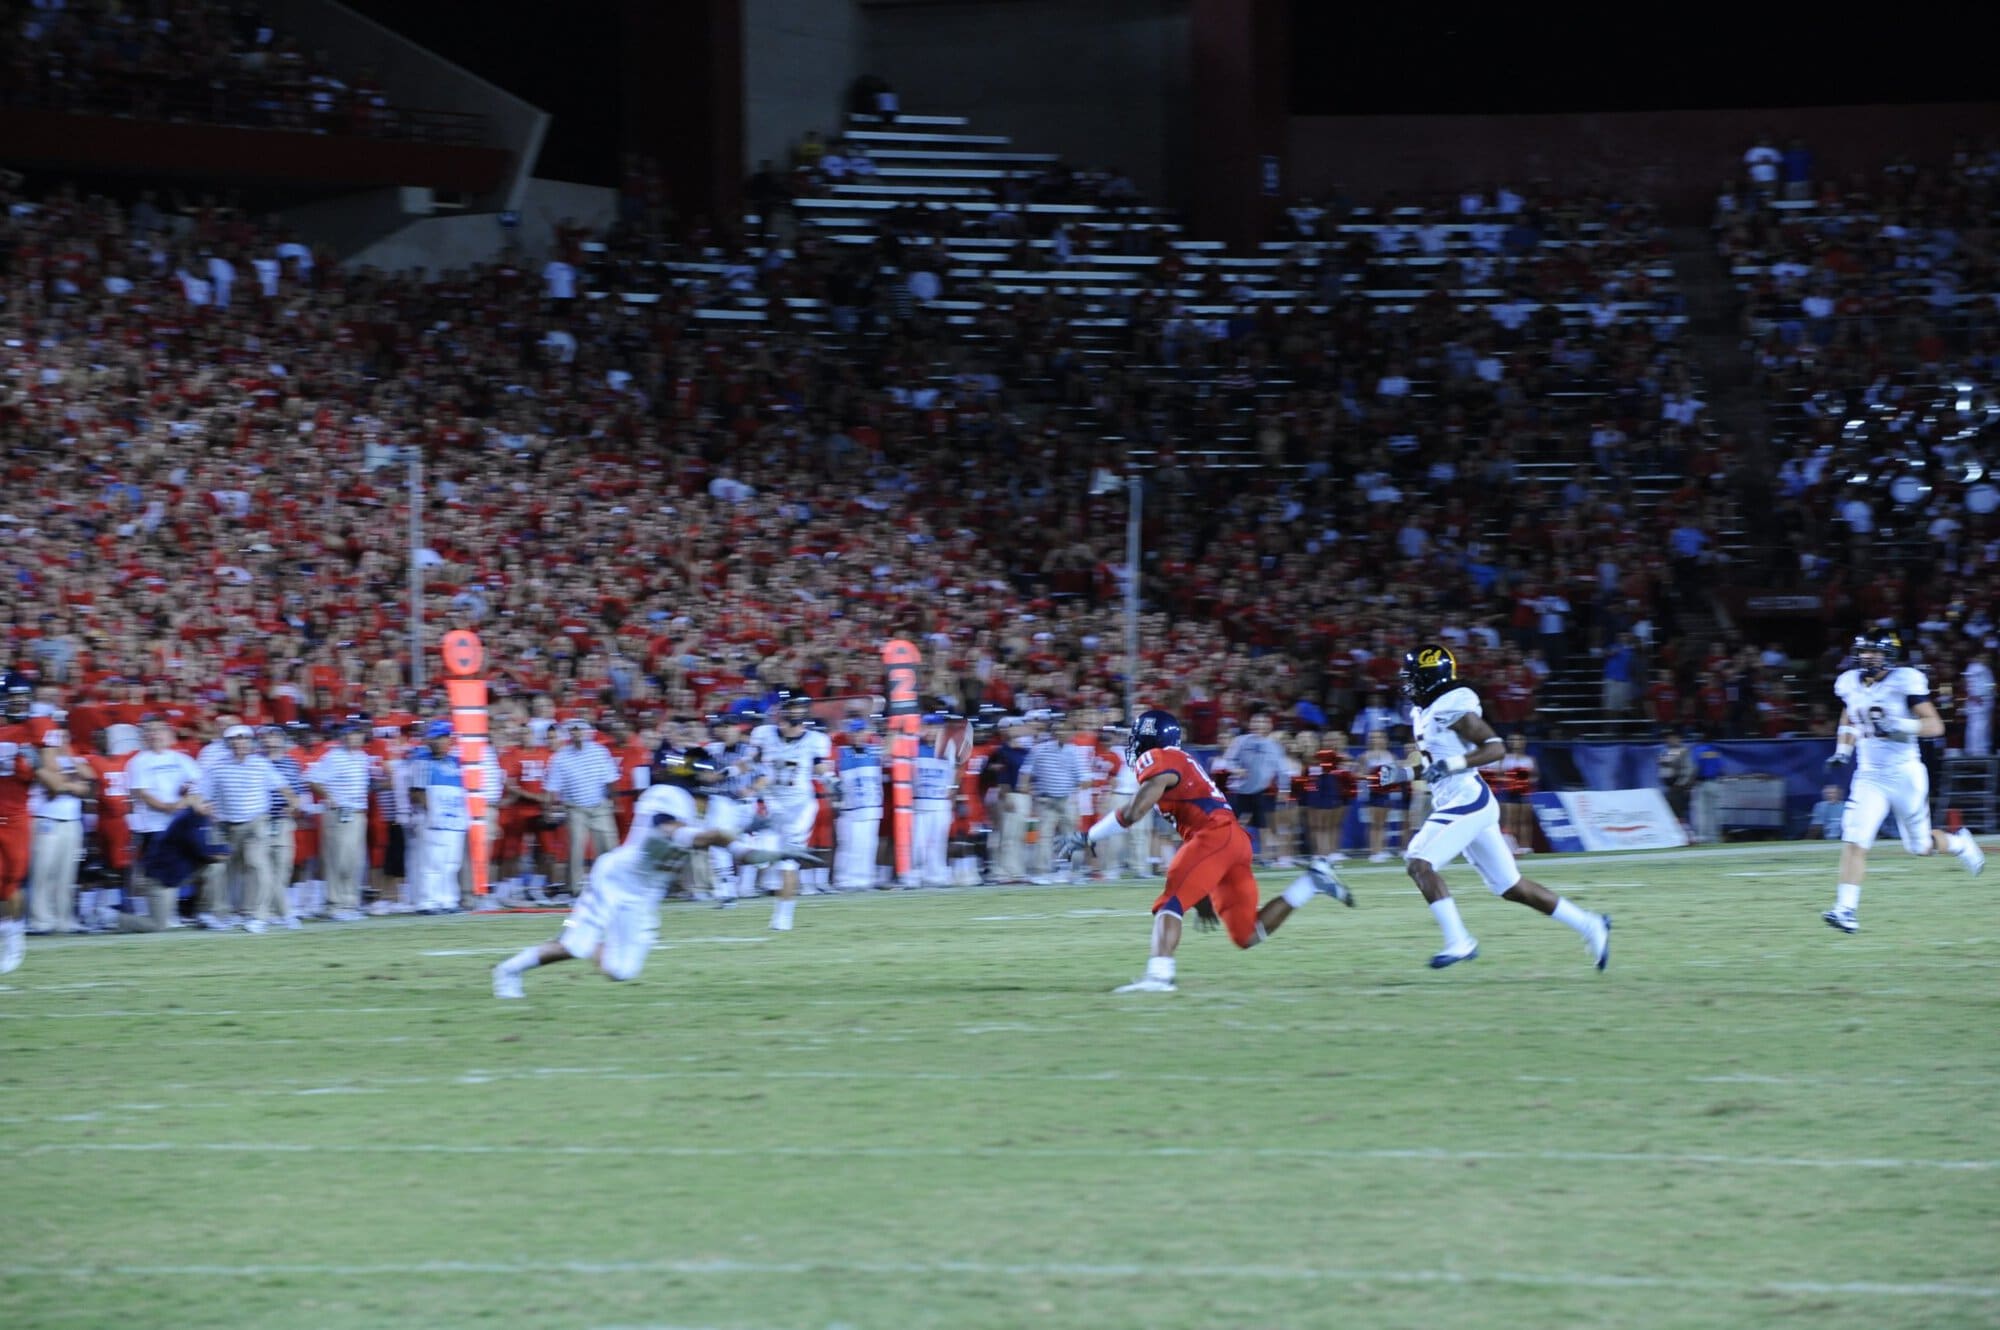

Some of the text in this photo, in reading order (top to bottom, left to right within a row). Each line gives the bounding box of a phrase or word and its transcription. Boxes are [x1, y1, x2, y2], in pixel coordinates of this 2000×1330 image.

[1418, 648, 1442, 668] Cal
[888, 667, 917, 702] 2
[1140, 717, 1158, 736] A
